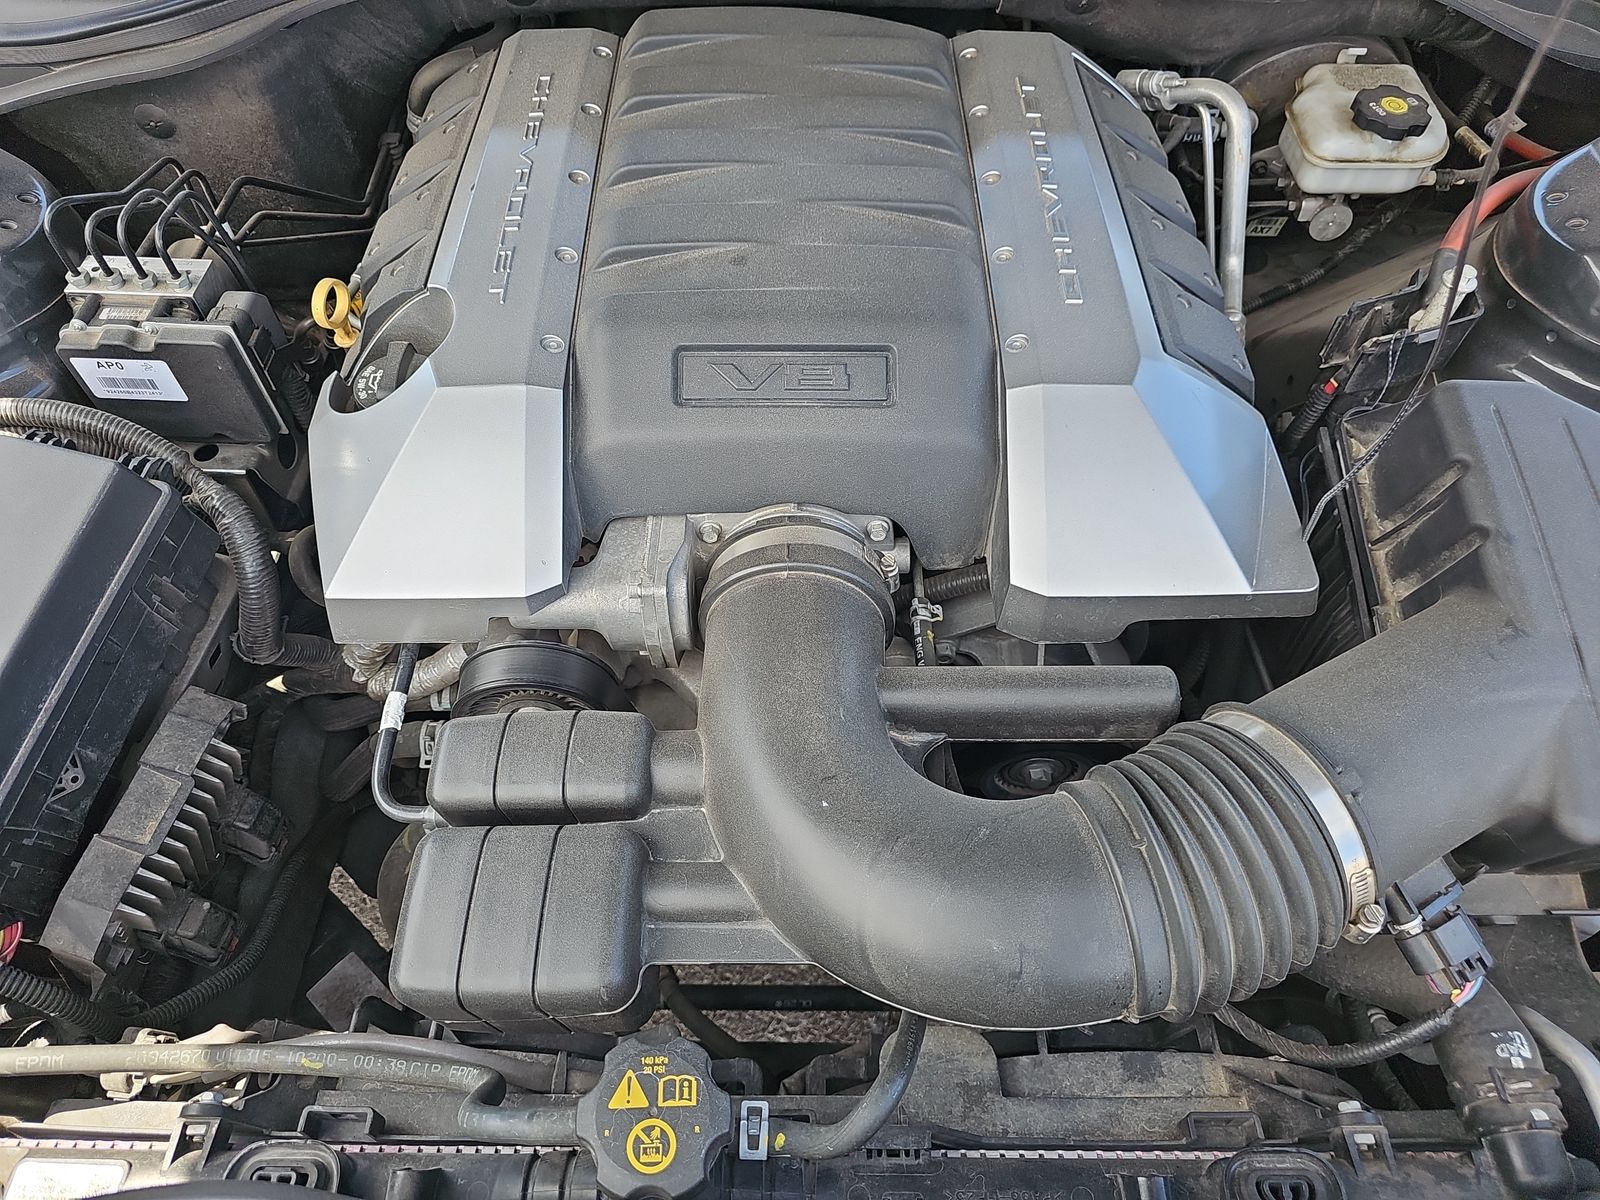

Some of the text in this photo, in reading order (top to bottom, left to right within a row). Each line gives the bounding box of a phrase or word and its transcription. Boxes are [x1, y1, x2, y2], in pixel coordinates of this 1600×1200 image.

[487, 74, 555, 305] CHEVROLET
[1014, 76, 1084, 304] CHEVROLET
[1249, 225, 1273, 234] AX7
[708, 362, 851, 392] V8
[914, 636, 924, 659] ENG
[640, 1056, 669, 1065] 140 kPa
[643, 1065, 666, 1074] 20 PSI
